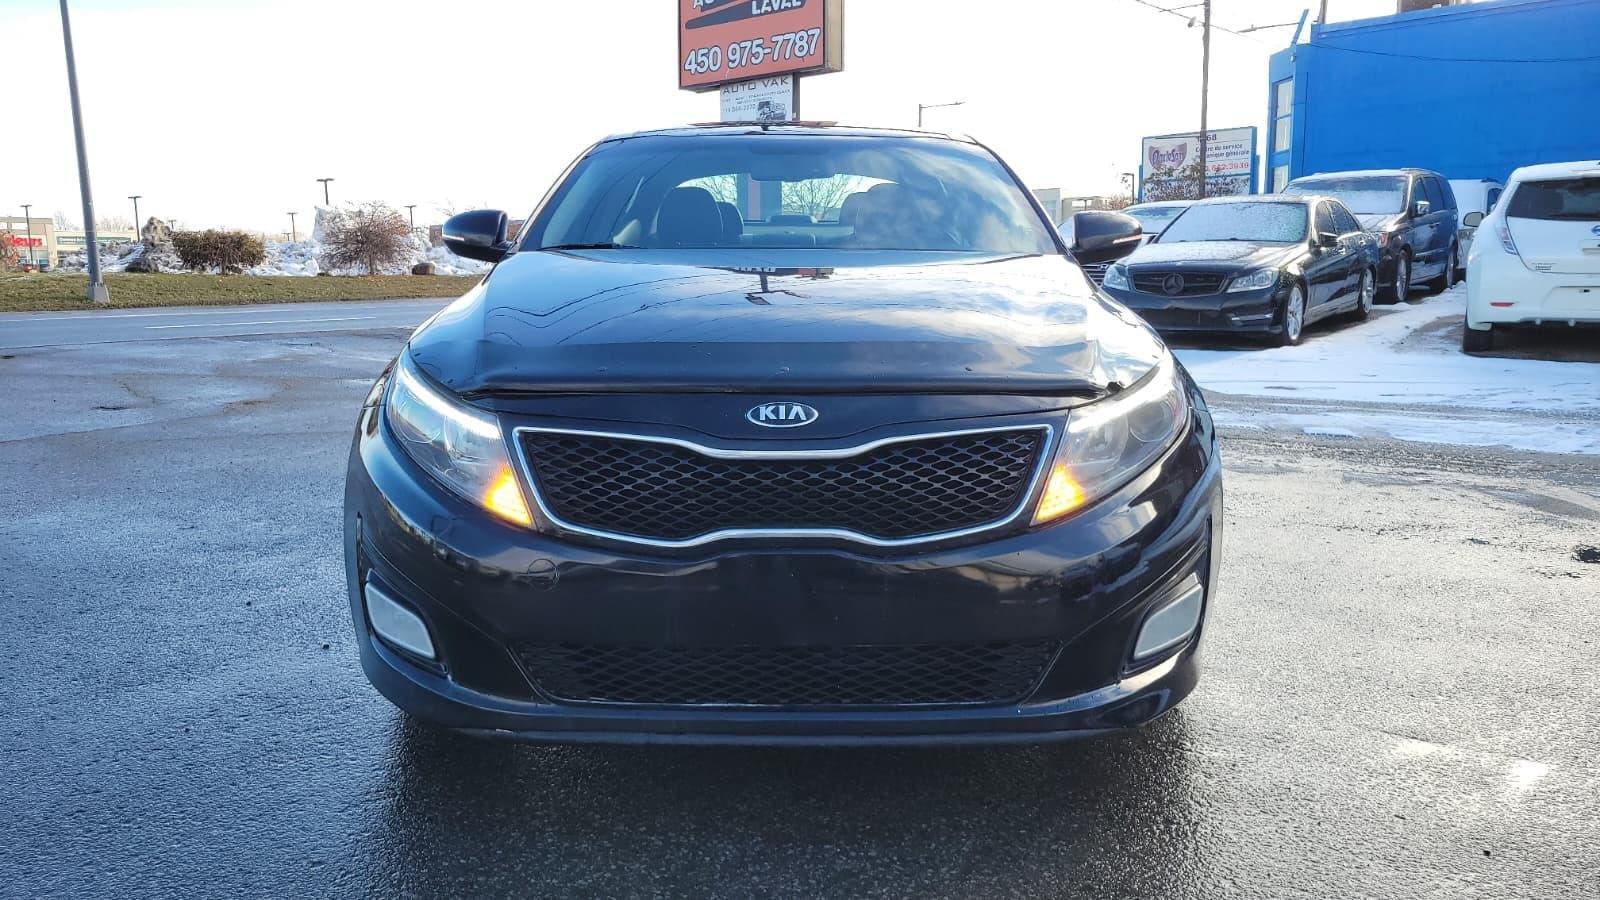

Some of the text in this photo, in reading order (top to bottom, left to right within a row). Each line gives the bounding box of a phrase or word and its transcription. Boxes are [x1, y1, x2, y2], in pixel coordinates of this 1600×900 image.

[685, 28, 821, 74] 450 975-7787
[722, 82, 756, 96] AUTO
[762, 76, 789, 88] VAK
[759, 405, 807, 420] KIA
